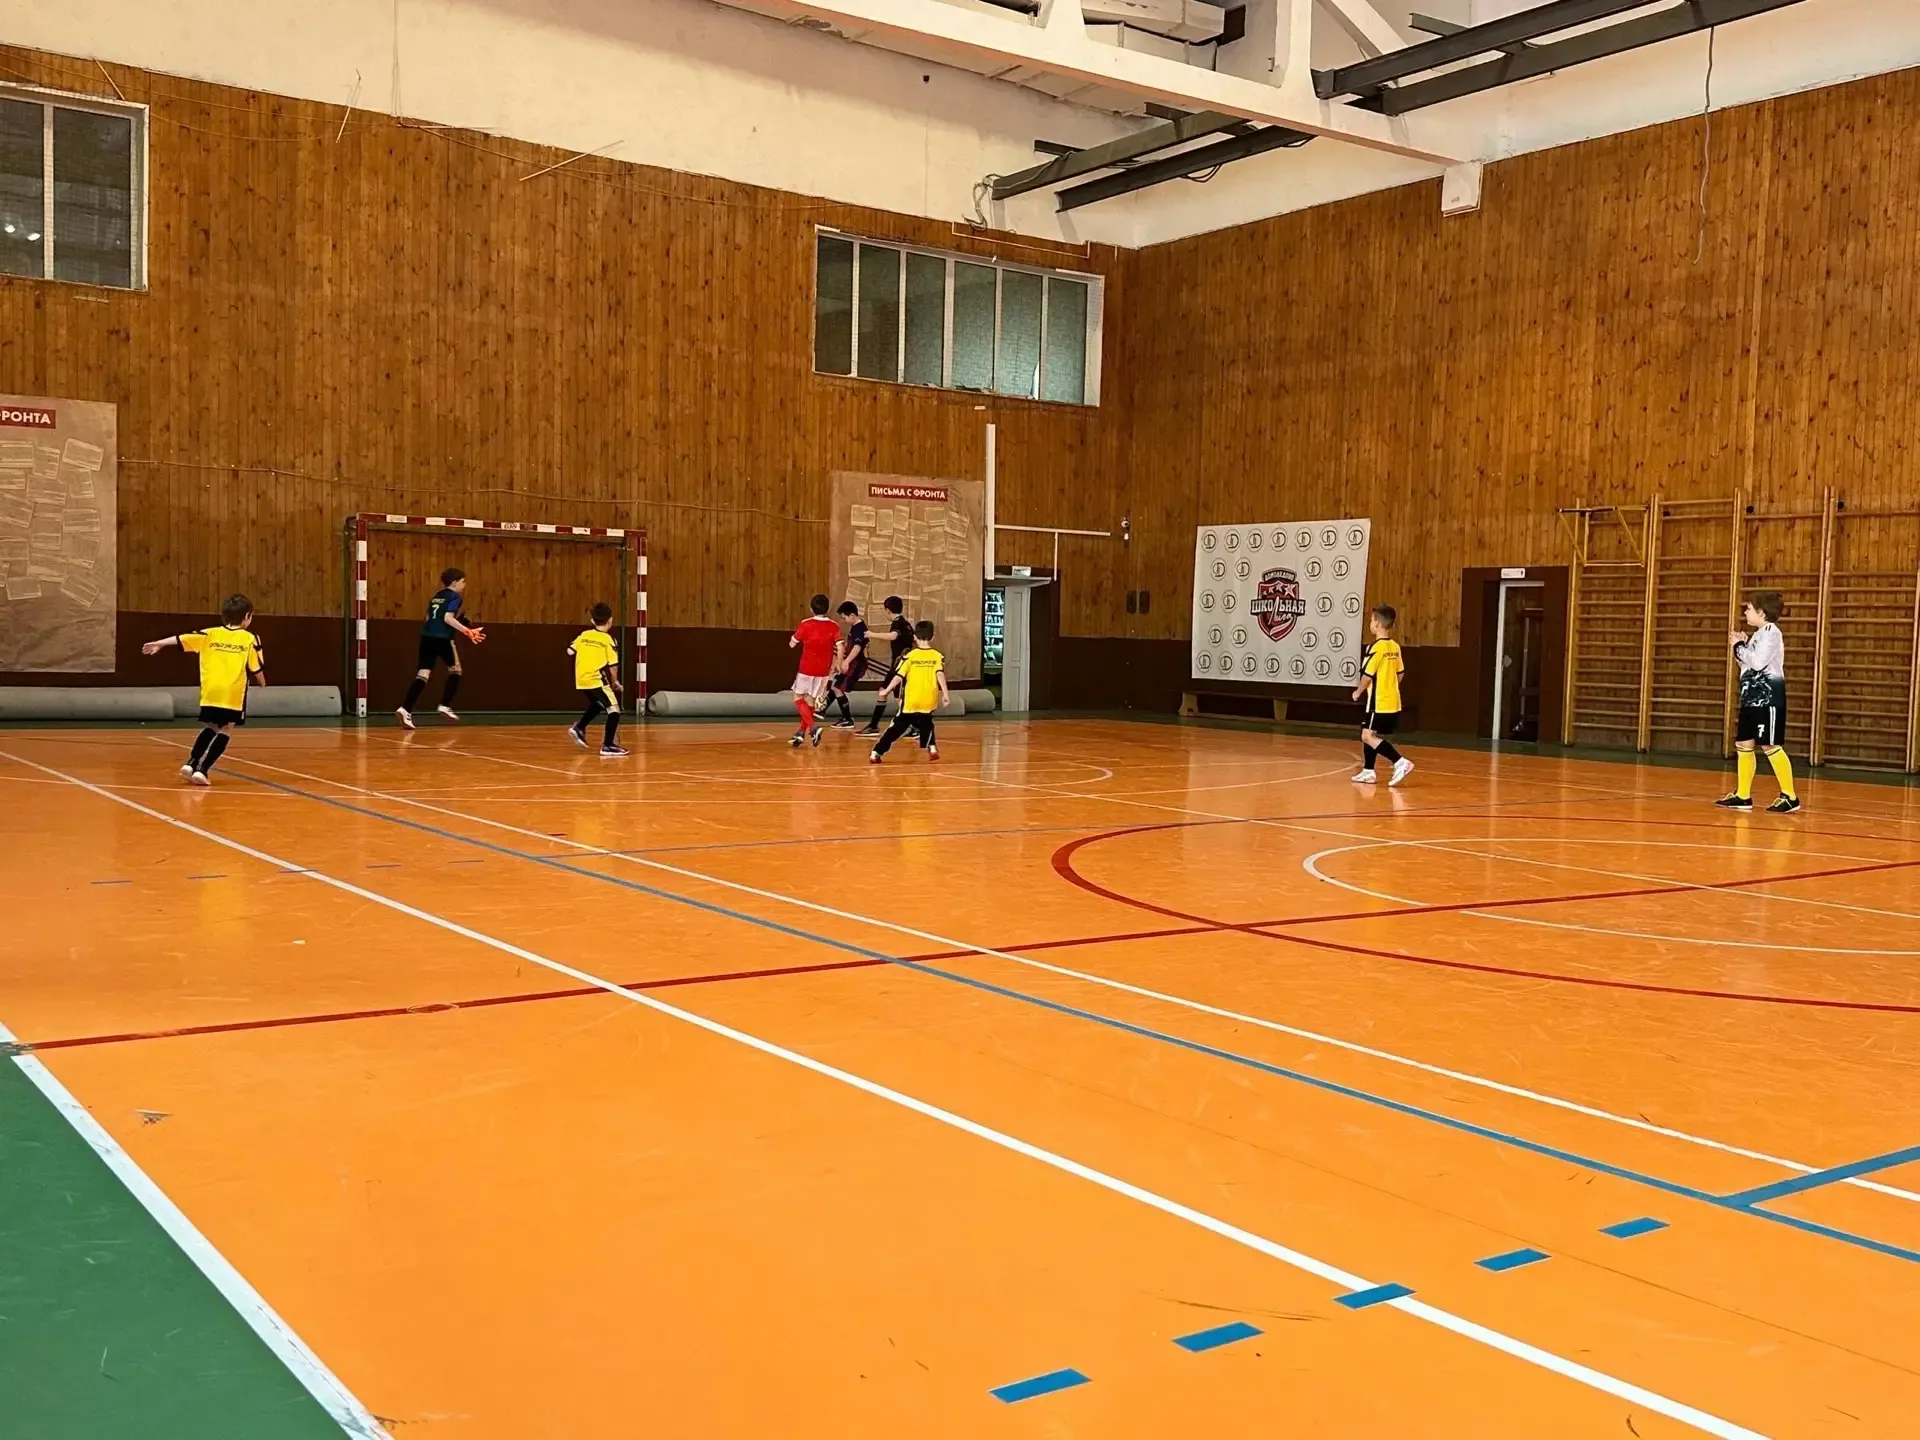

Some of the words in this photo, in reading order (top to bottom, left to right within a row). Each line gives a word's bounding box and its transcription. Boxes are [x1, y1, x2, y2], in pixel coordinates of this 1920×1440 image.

[0, 410, 51, 424] РОНТА
[871, 487, 905, 497] ПИСЬМА
[906, 489, 912, 497] С
[913, 489, 945, 499] ФРОНТА
[431, 604, 440, 619] 7
[1757, 724, 1765, 738] 7
